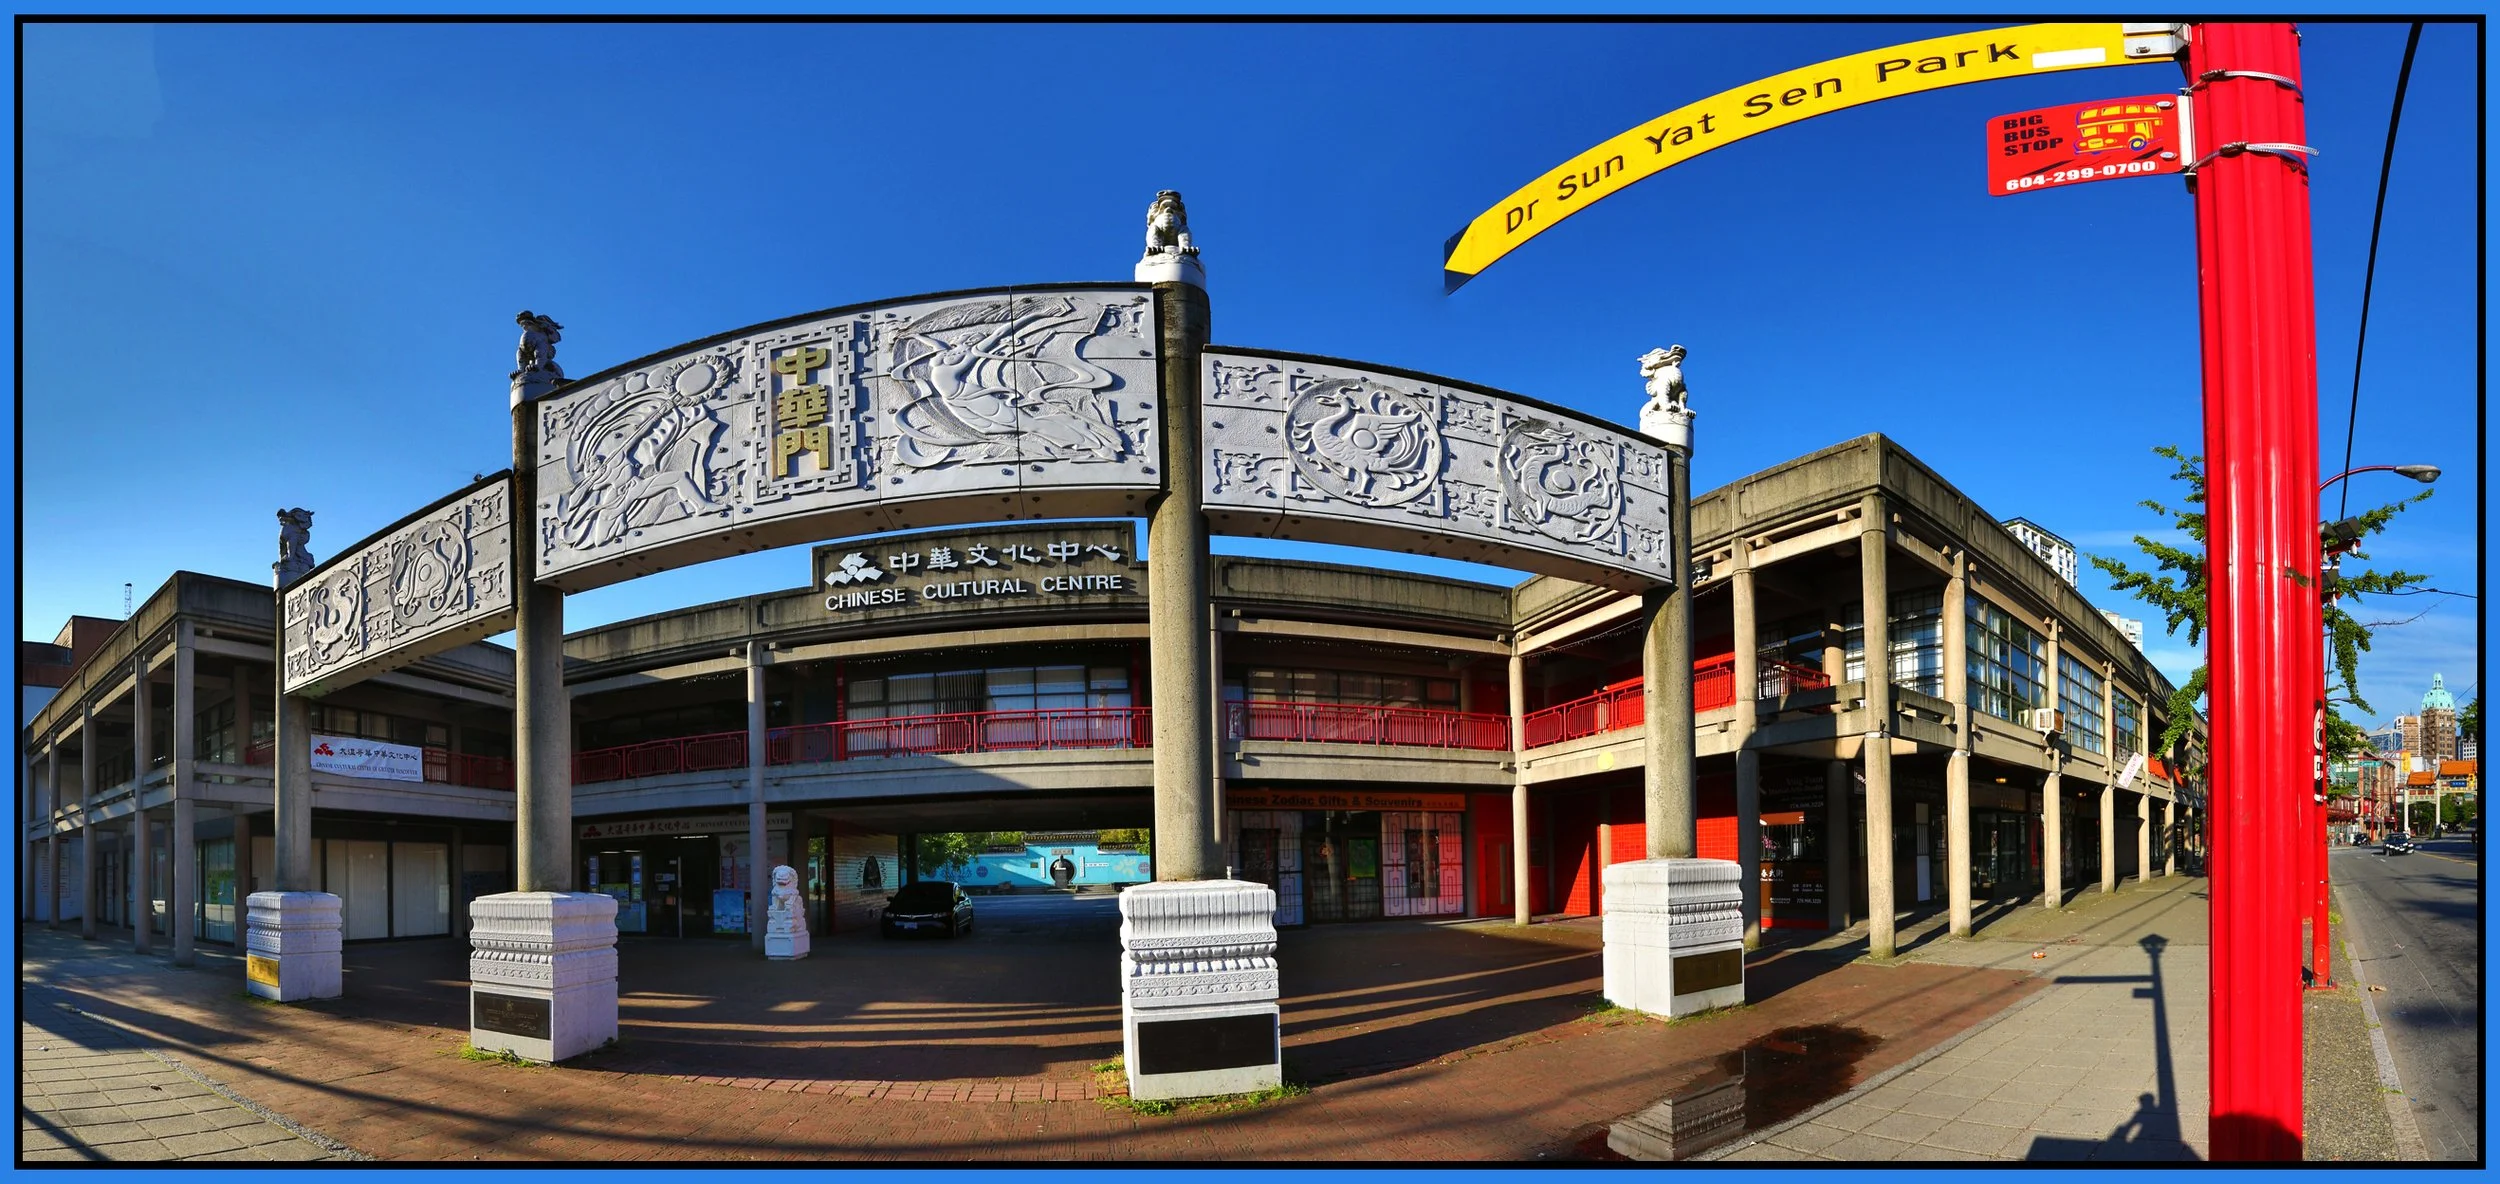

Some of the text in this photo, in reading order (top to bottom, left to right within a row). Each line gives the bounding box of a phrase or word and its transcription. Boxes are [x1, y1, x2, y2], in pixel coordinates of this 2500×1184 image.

[2004, 115, 2043, 130] BIG
[2004, 126, 2050, 143] BUS
[1506, 41, 2020, 235] Dr Sun Yat Sen Park
[2004, 137, 2063, 157] STOP
[2006, 161, 2156, 191] 604-299-0700
[776, 346, 829, 477] 中華門
[889, 541, 1121, 573] 中華文化中心
[825, 574, 1123, 610] CHINESE CULTURAL CENTRE
[1272, 794, 1314, 806] Zodiac
[1318, 795, 1348, 806] Gifts
[1365, 796, 1422, 807] Souvenirs
